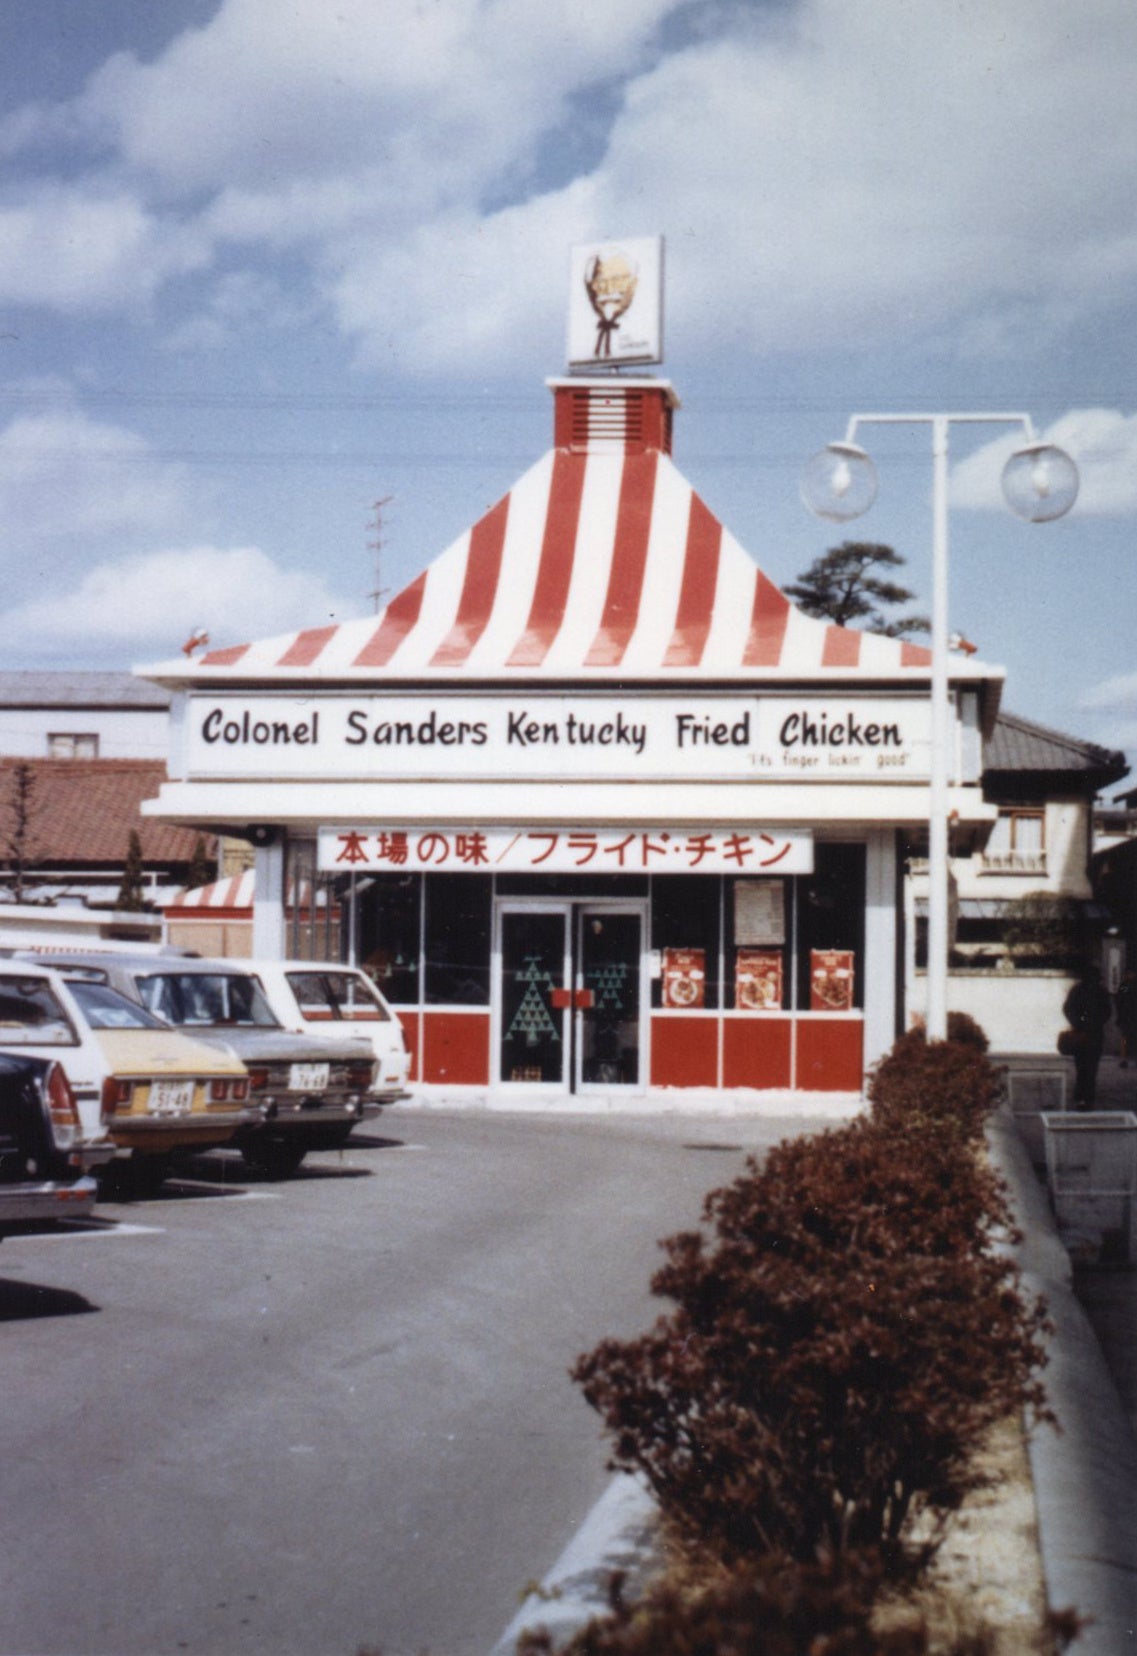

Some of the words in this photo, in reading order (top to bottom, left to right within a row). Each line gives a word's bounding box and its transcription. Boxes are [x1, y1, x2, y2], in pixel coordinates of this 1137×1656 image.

[203, 708, 318, 745] Colonel
[346, 710, 487, 746] Sanders
[508, 711, 646, 753] Kentucky
[677, 711, 750, 748] Fried
[780, 711, 902, 747] Chicken
